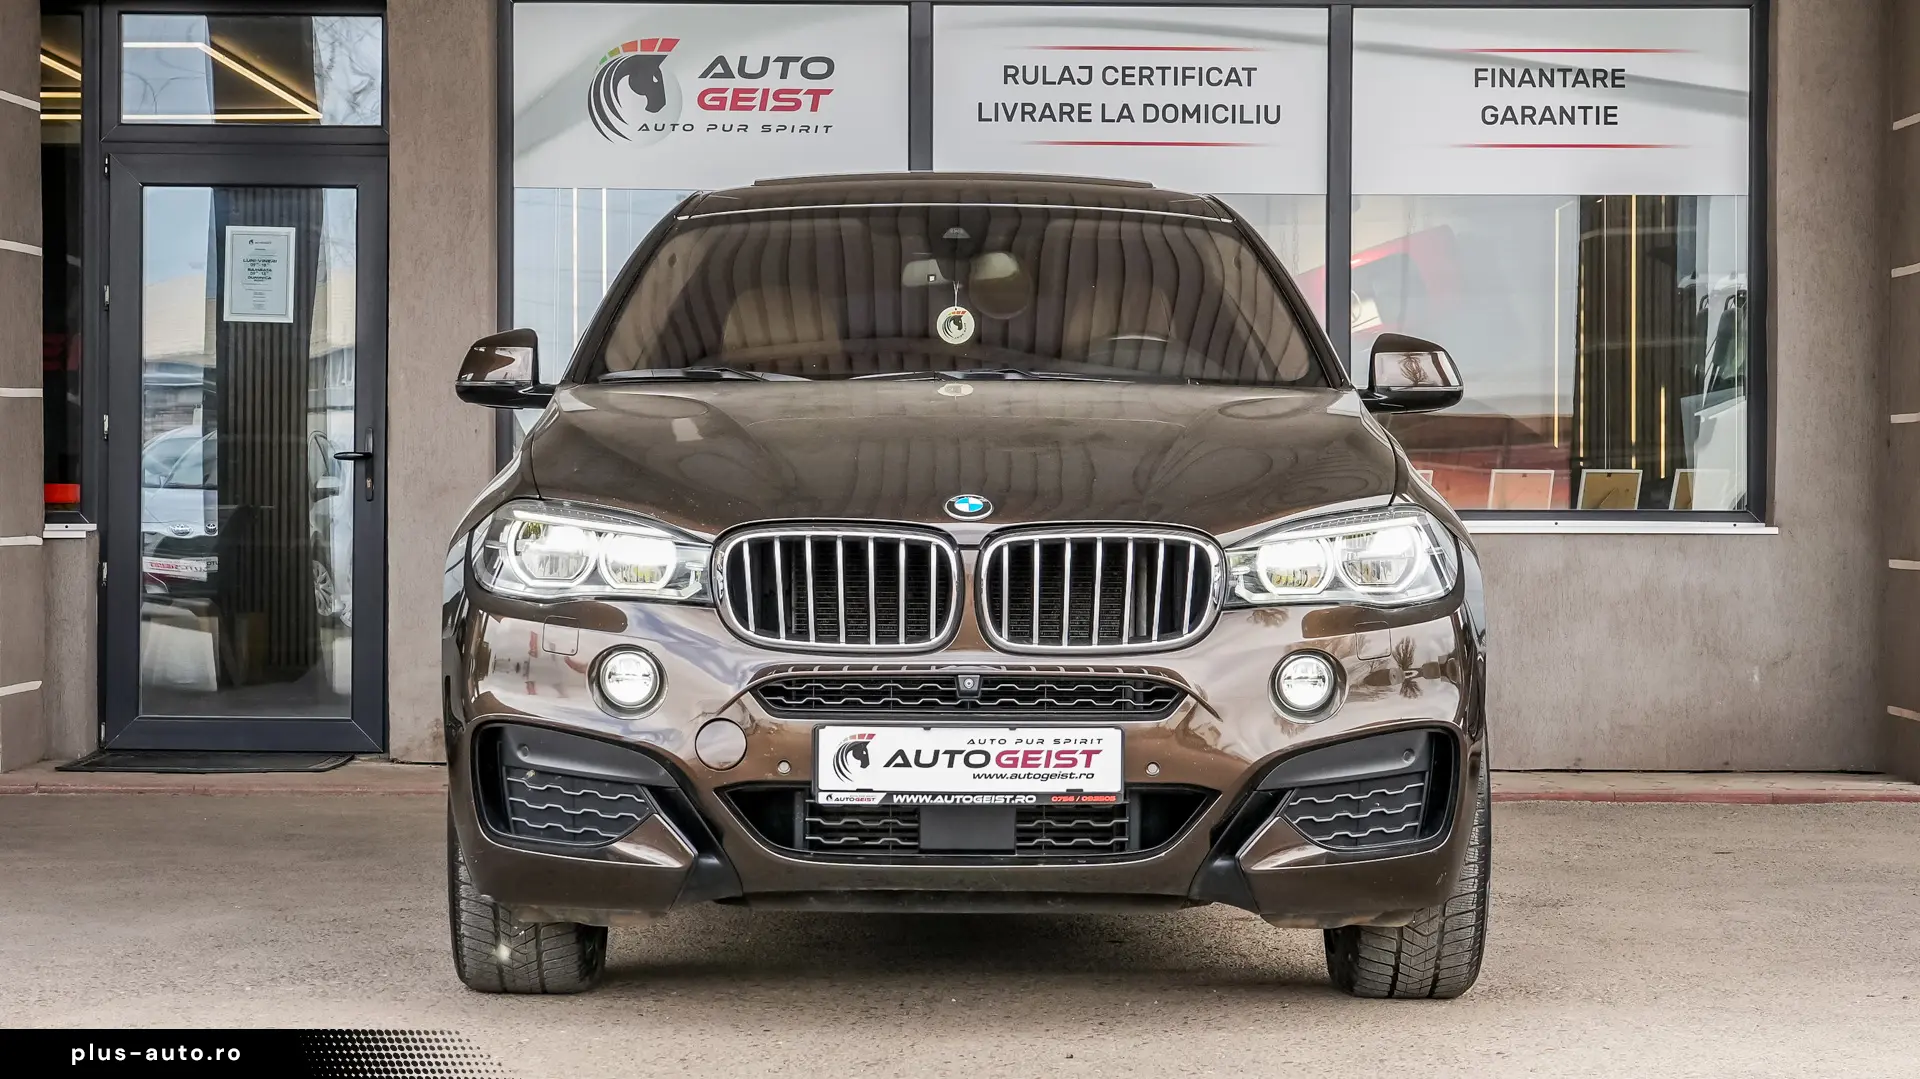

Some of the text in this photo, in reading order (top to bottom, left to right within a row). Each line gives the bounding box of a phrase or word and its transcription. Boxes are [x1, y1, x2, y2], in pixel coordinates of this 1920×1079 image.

[698, 55, 835, 80] AUTO
[1003, 65, 1258, 88] RULAJ CERTIFICAT
[1474, 68, 1626, 89] FINANTARE
[697, 87, 834, 112] GEIST
[977, 102, 1281, 125] LIVRARE LA DOMICILIU
[1480, 105, 1619, 126] GARANTIE
[637, 123, 833, 134] AUTO PUR SPIRIT
[883, 749, 1103, 769] AUTOGEIST
[972, 771, 1095, 782] www.autogeist.ro
[892, 794, 1037, 804] WWW.AUTOGEIST.RO
